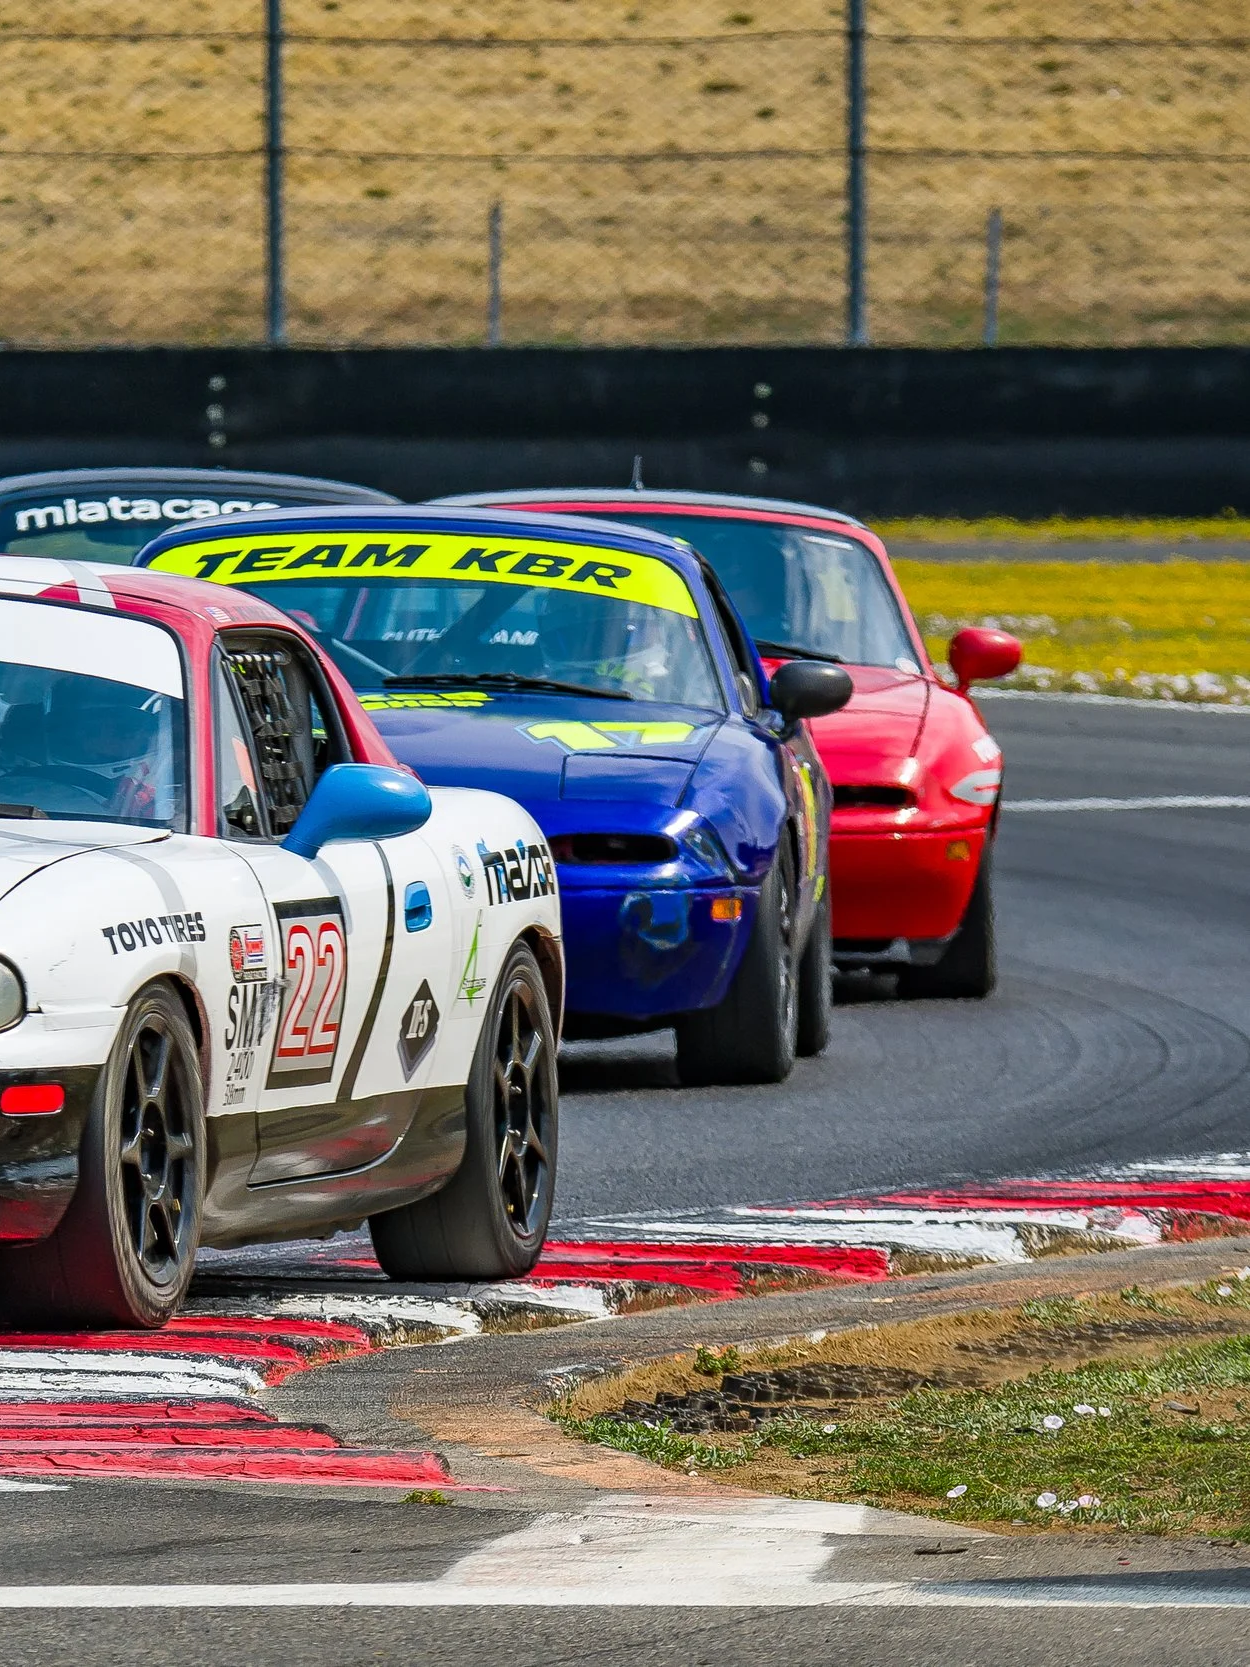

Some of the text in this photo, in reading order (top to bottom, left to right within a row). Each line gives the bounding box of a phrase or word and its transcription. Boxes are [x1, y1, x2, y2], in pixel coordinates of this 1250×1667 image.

[15, 496, 283, 531] miataca
[196, 543, 633, 590] TEAM KBR
[524, 719, 697, 752] 17
[101, 911, 206, 955] TOYO TIRES
[277, 921, 344, 1058] 22
